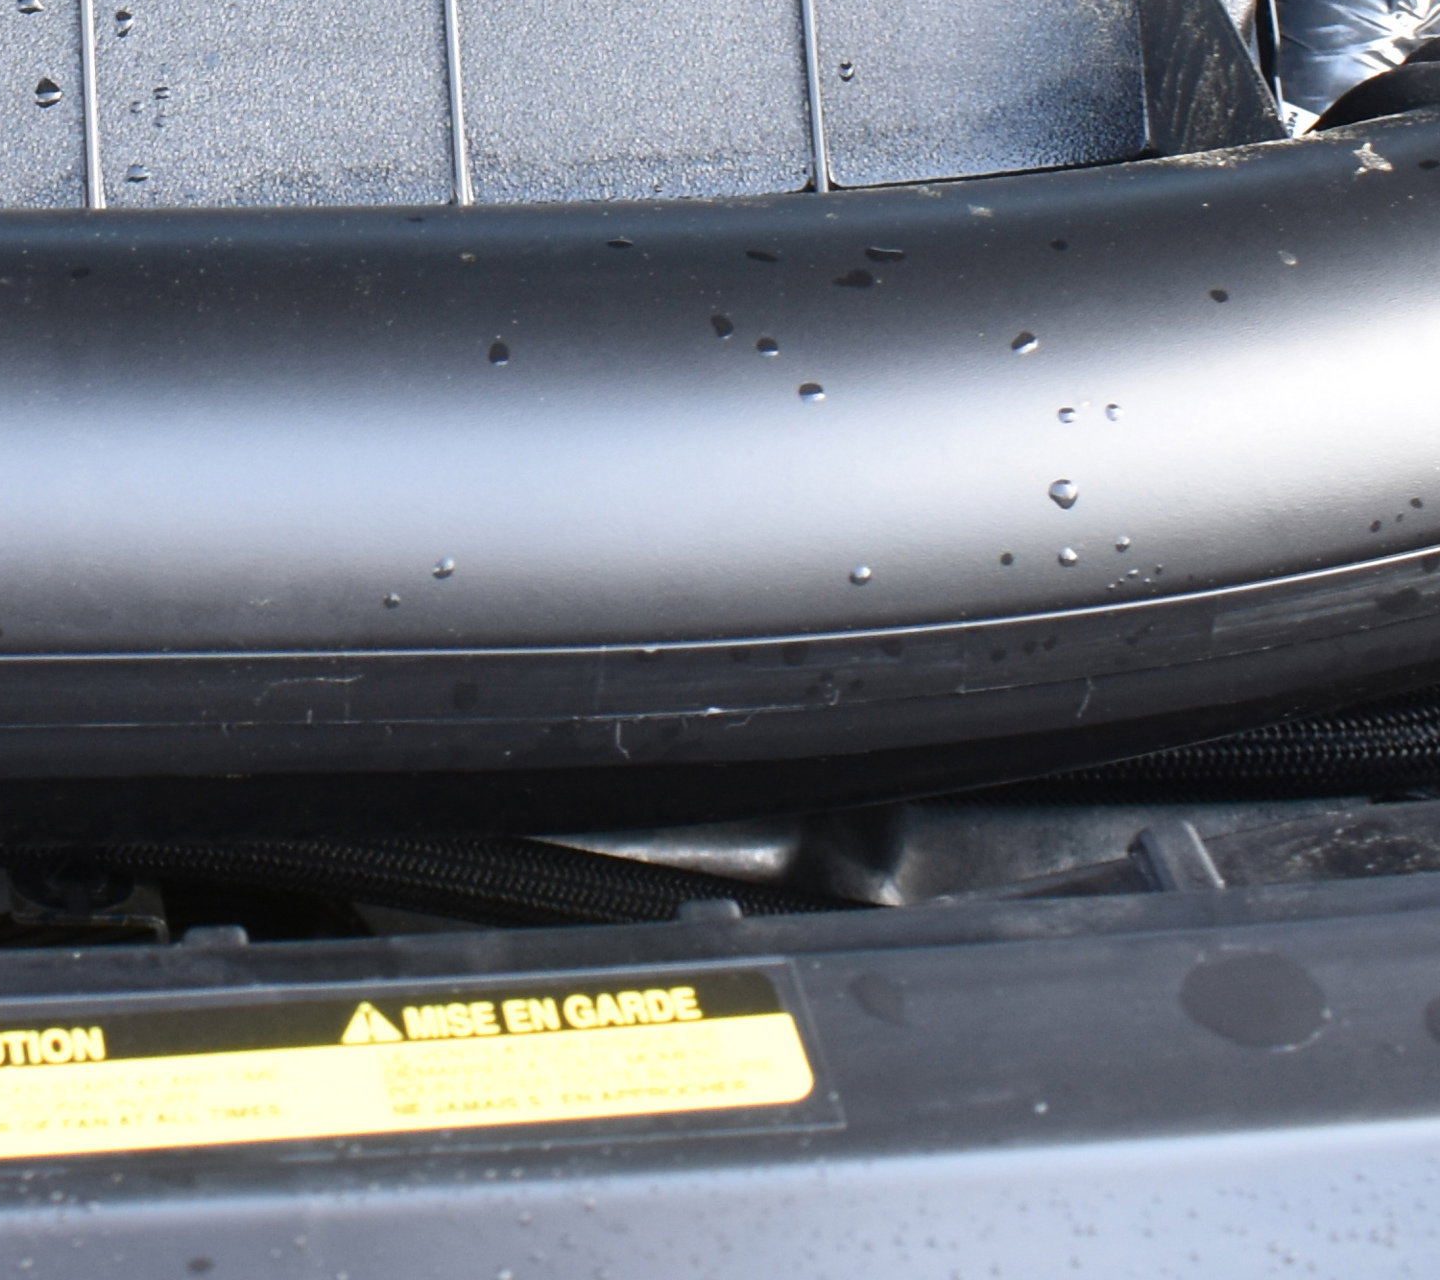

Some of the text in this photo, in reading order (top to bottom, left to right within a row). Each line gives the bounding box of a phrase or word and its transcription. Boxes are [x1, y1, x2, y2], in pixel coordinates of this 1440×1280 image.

[402, 987, 703, 1040] MISE EN GARDE
